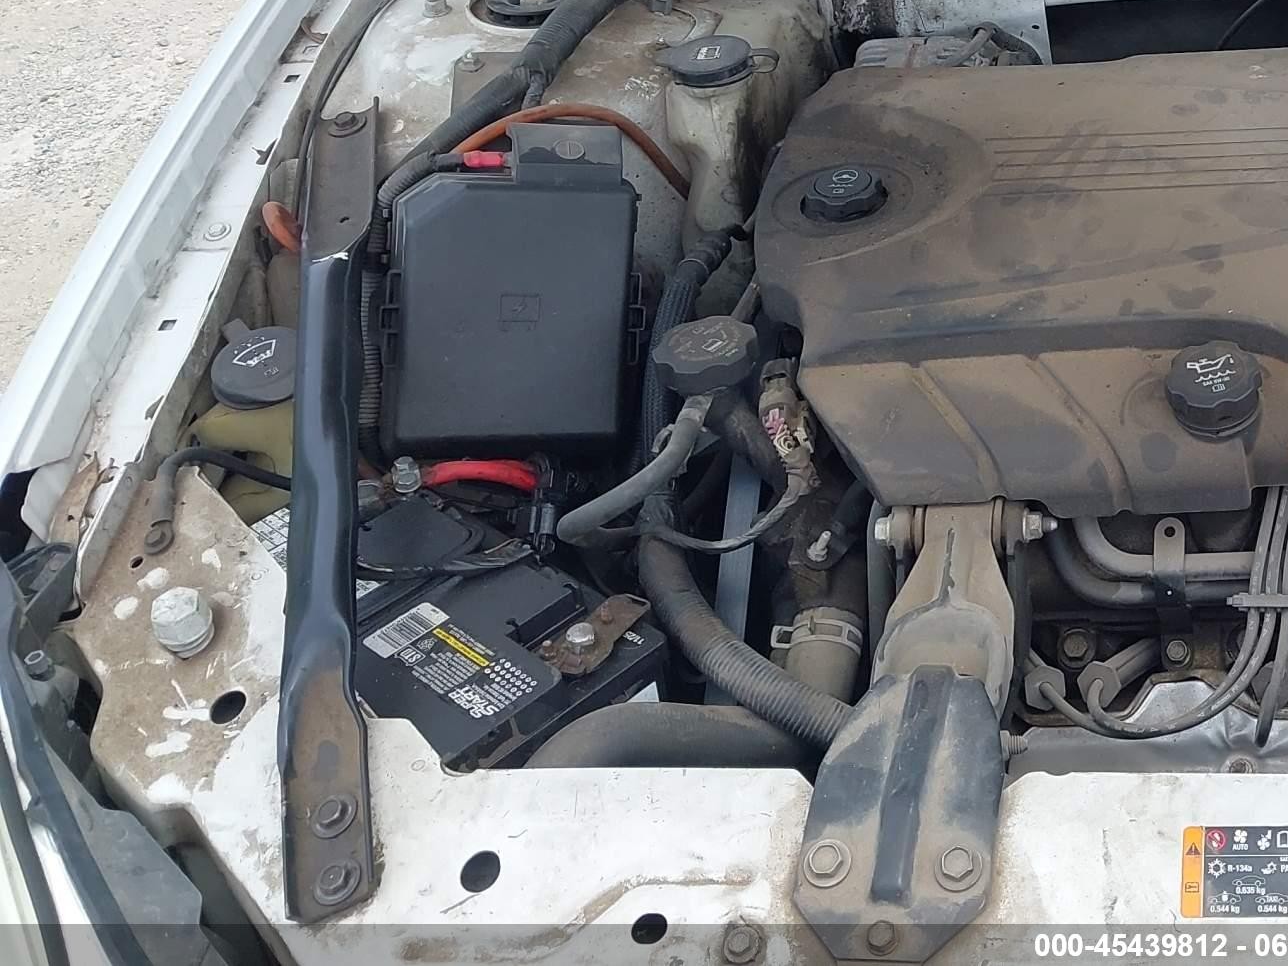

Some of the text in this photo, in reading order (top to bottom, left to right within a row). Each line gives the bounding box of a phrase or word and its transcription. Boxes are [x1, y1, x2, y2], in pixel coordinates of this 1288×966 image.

[448, 688, 482, 719] SUPER
[456, 686, 500, 716] START
[1232, 843, 1249, 851] AUTO
[1256, 886, 1266, 896] kg
[1210, 905, 1240, 914] 0.544 kg
[1278, 905, 1288, 914] kg
